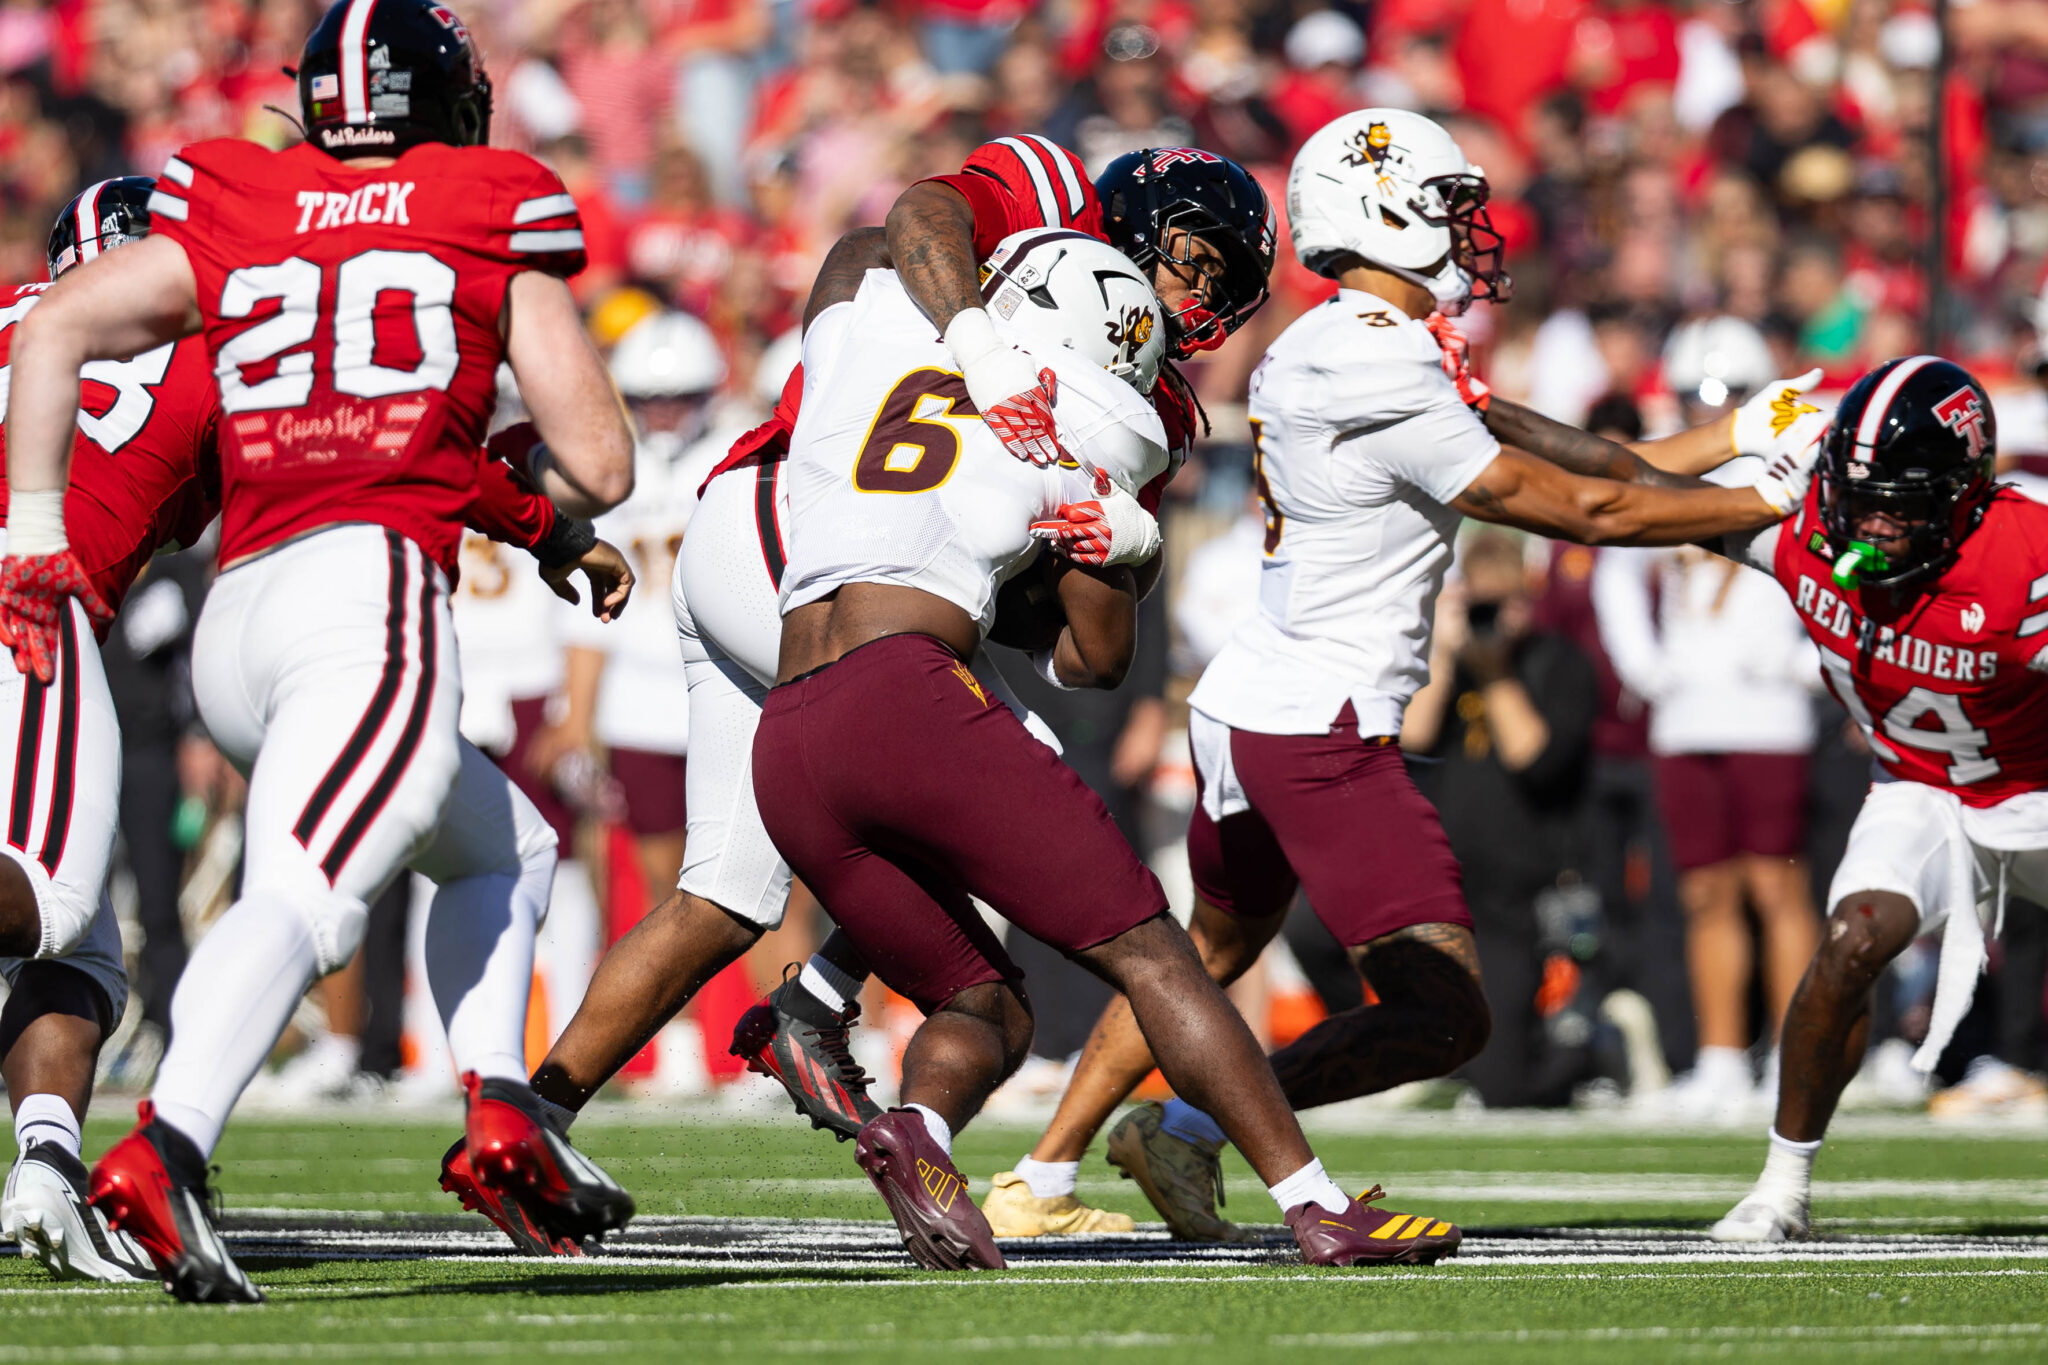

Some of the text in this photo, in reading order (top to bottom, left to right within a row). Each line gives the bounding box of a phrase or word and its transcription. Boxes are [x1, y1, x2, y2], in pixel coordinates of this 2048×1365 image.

[322, 126, 396, 148] Red Raiders
[296, 182, 415, 235] TRICK
[213, 248, 460, 416] 20
[1357, 310, 1399, 327] 3
[276, 411, 334, 448] Guns
[852, 365, 985, 494] 6
[1796, 573, 1998, 683] RED RAIDERS
